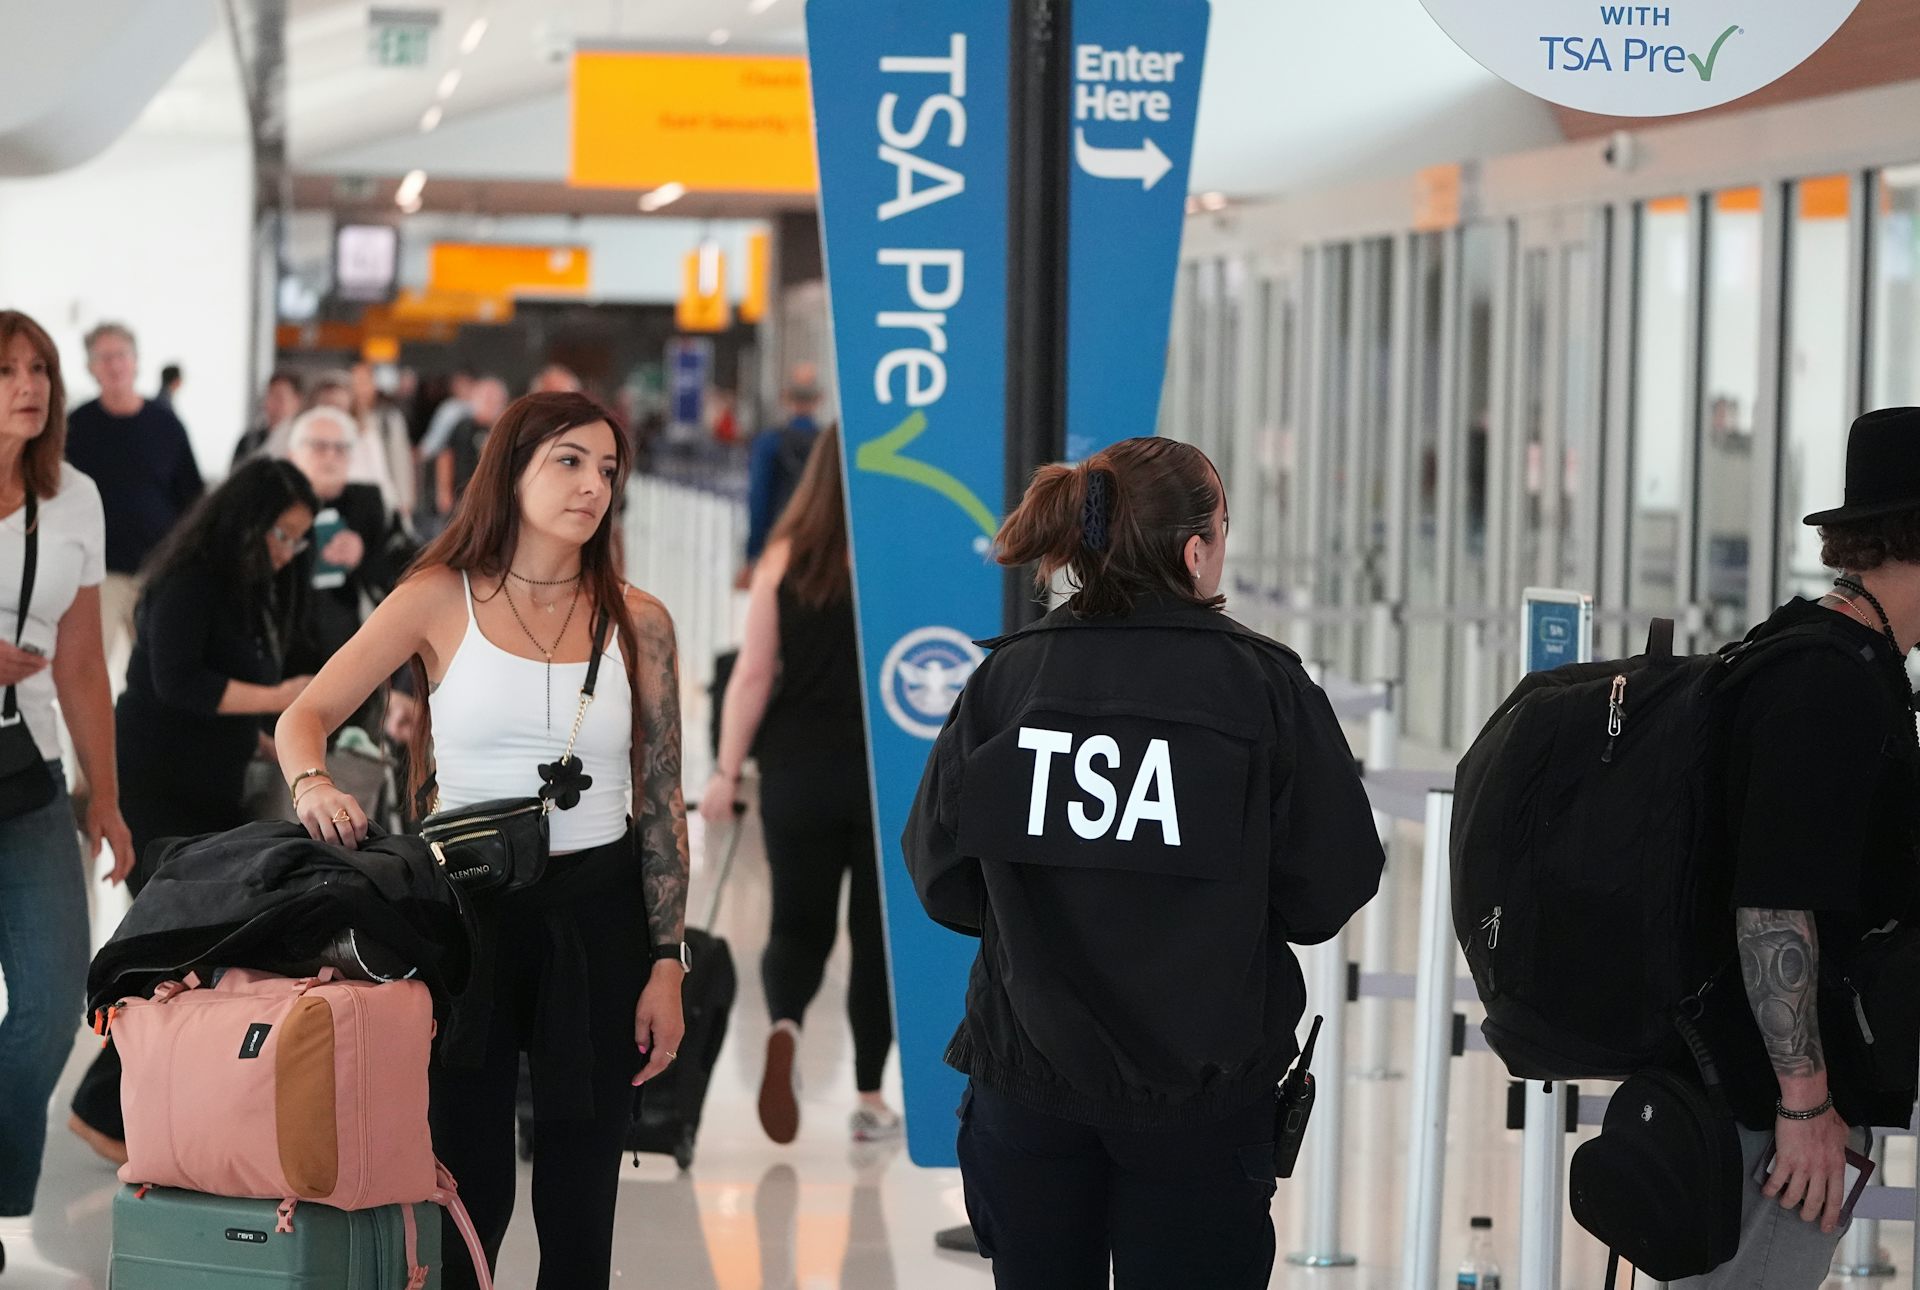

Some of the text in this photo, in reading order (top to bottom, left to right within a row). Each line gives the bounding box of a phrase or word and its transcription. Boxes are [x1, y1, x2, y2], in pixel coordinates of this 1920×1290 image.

[1600, 6, 1670, 26] WITH
[1076, 44, 1184, 82] Enter
[1539, 36, 1686, 73] TSA Pre
[1075, 83, 1171, 121] Here
[874, 32, 967, 407] TSA Pre
[1018, 726, 1181, 846] TSA
[449, 864, 490, 880] ALENTINO
